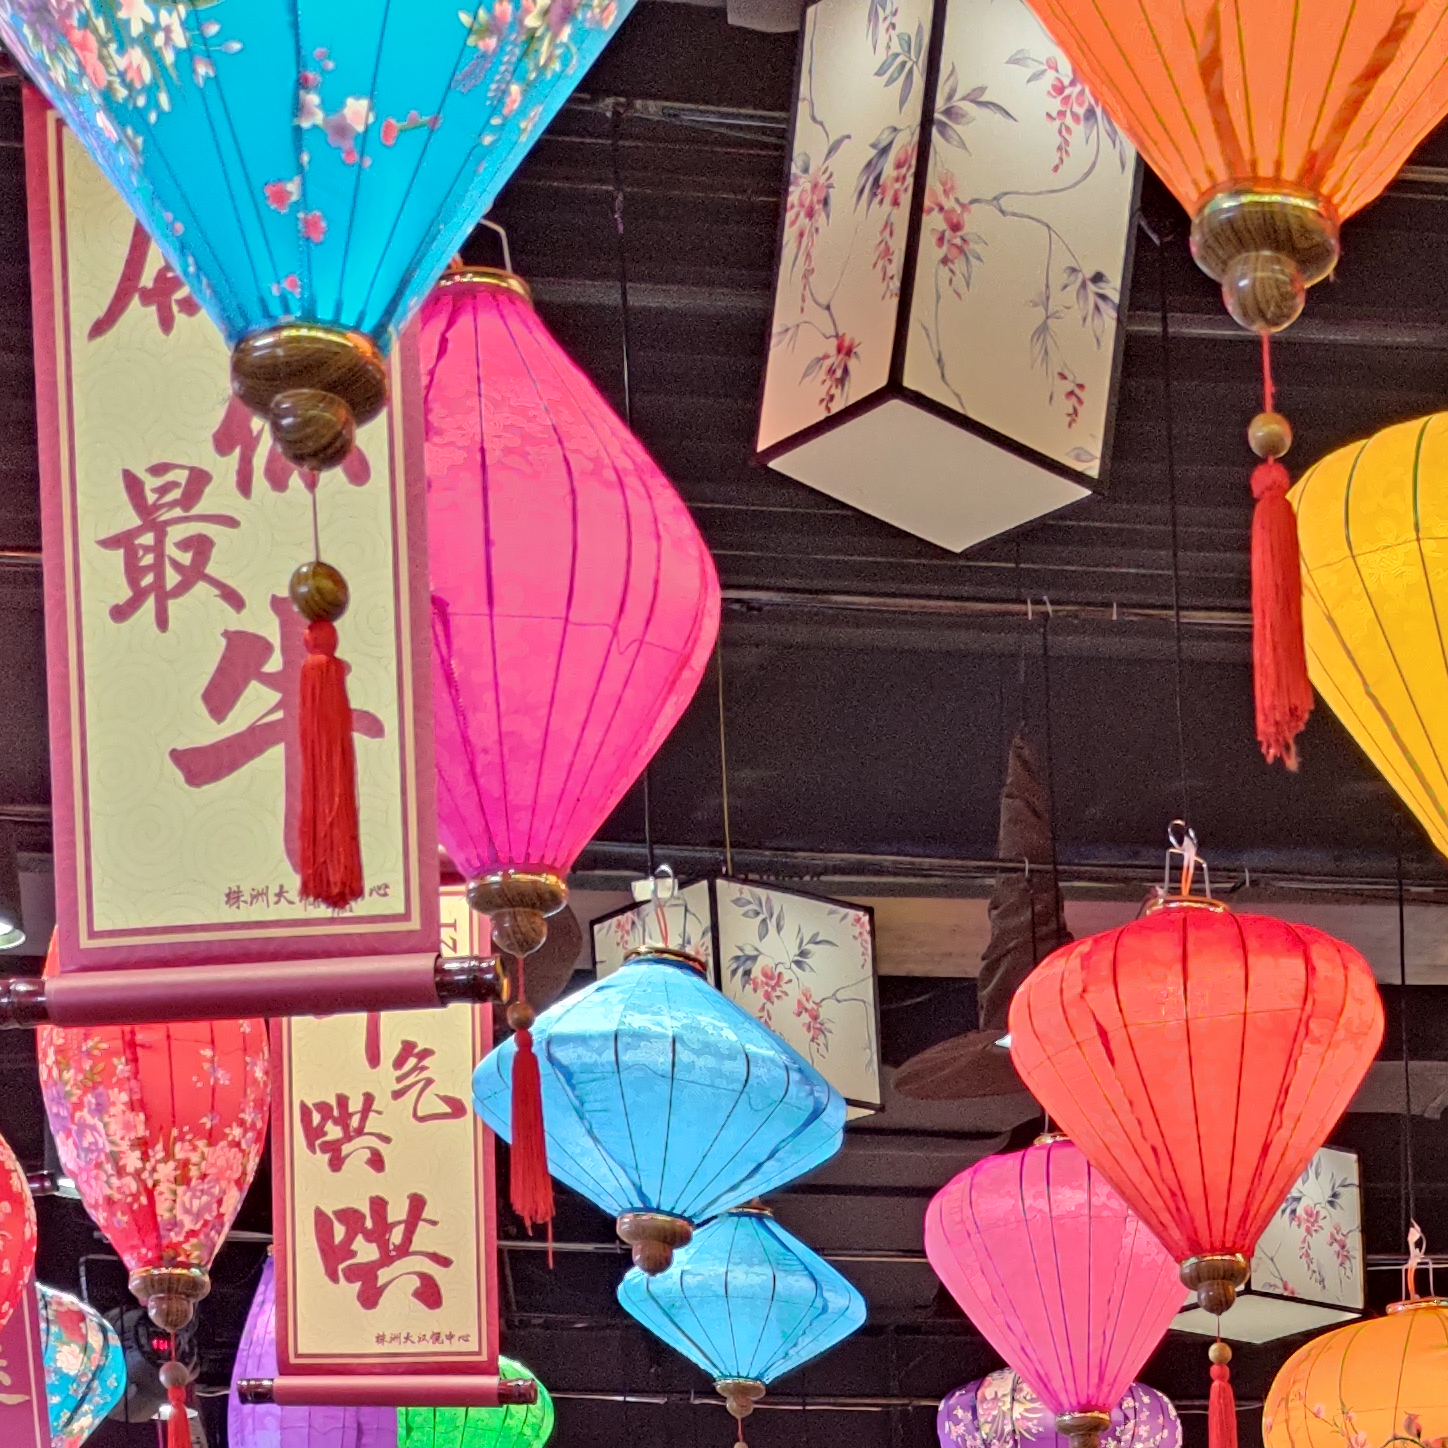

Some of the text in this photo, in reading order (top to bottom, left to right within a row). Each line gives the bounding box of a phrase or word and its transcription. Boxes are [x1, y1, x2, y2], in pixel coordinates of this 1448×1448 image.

[224, 878, 392, 912] 株洲大心
[299, 1010, 464, 1310] 气哄哄
